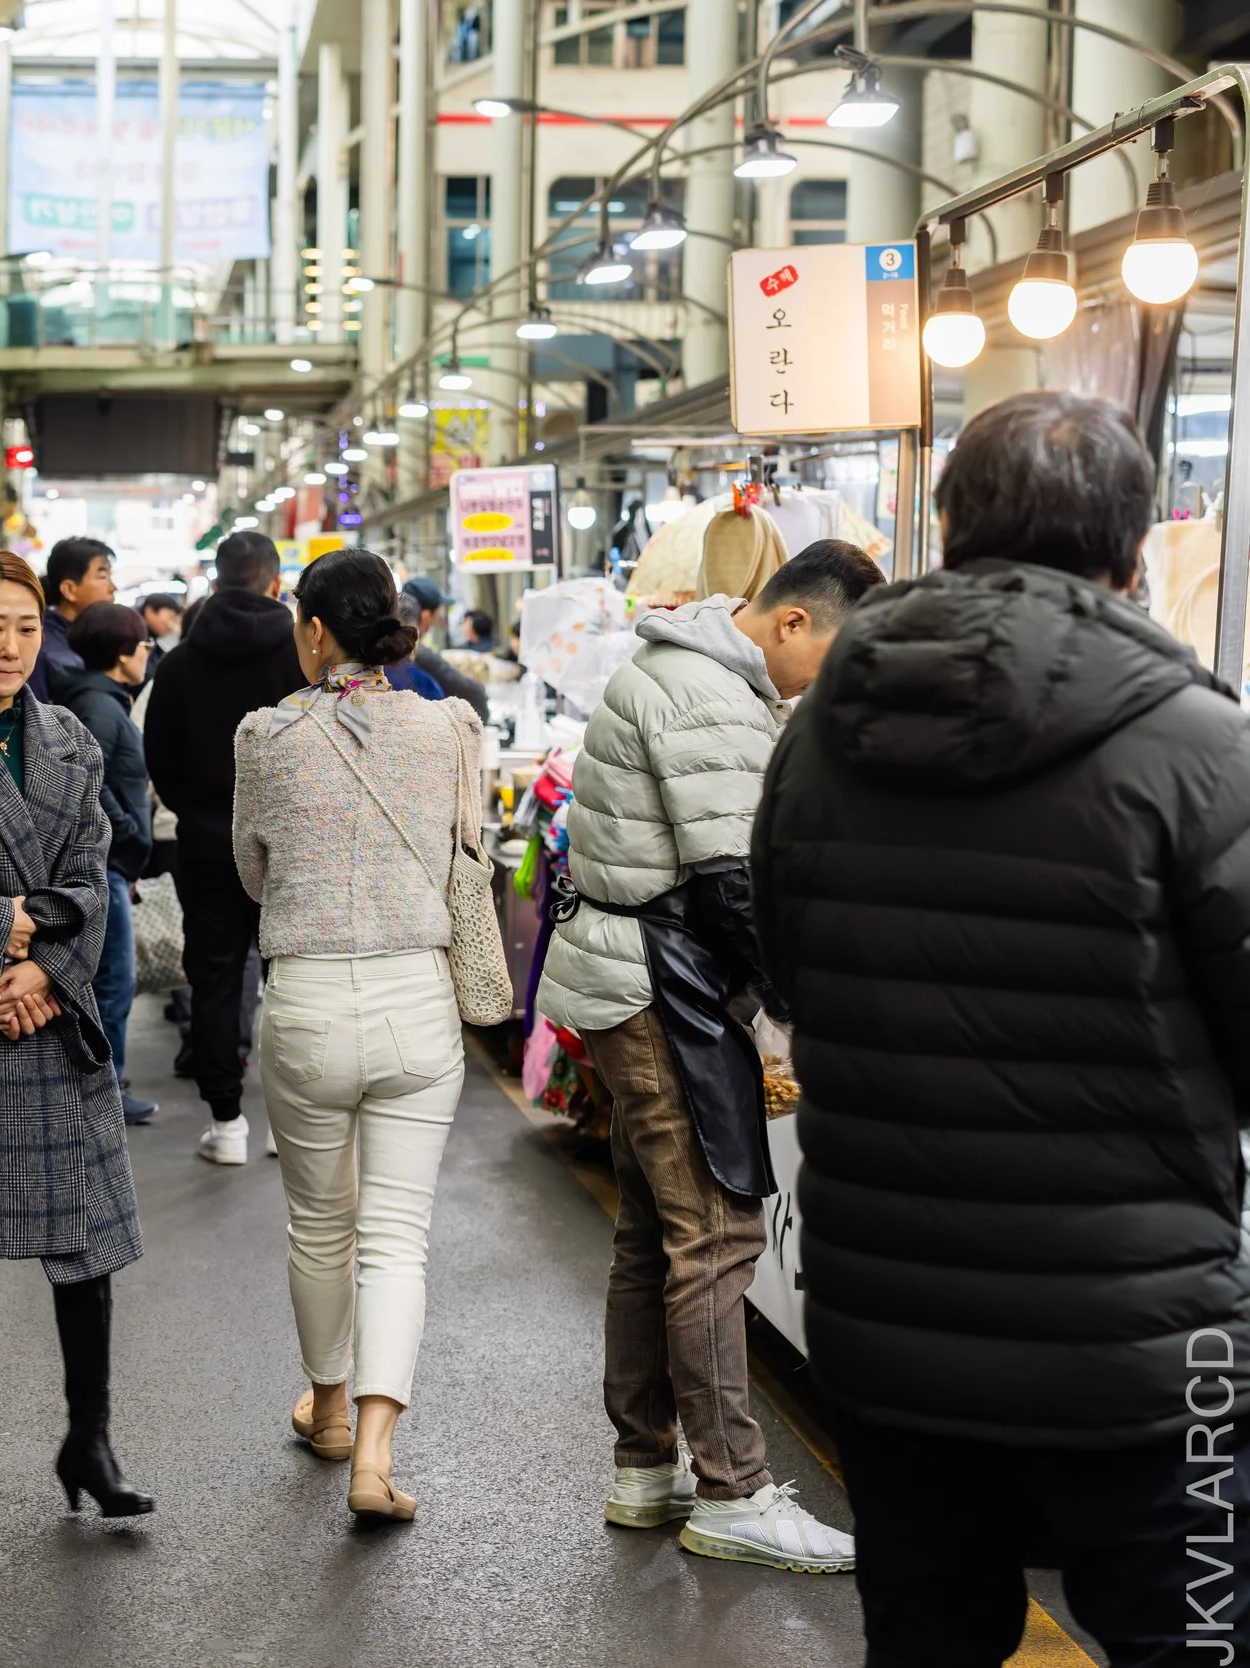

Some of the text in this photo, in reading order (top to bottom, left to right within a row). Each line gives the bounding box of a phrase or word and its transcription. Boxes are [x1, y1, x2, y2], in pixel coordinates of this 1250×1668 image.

[885, 253, 895, 266] 3
[766, 268, 795, 292] 수제
[766, 308, 795, 415] 오란다
